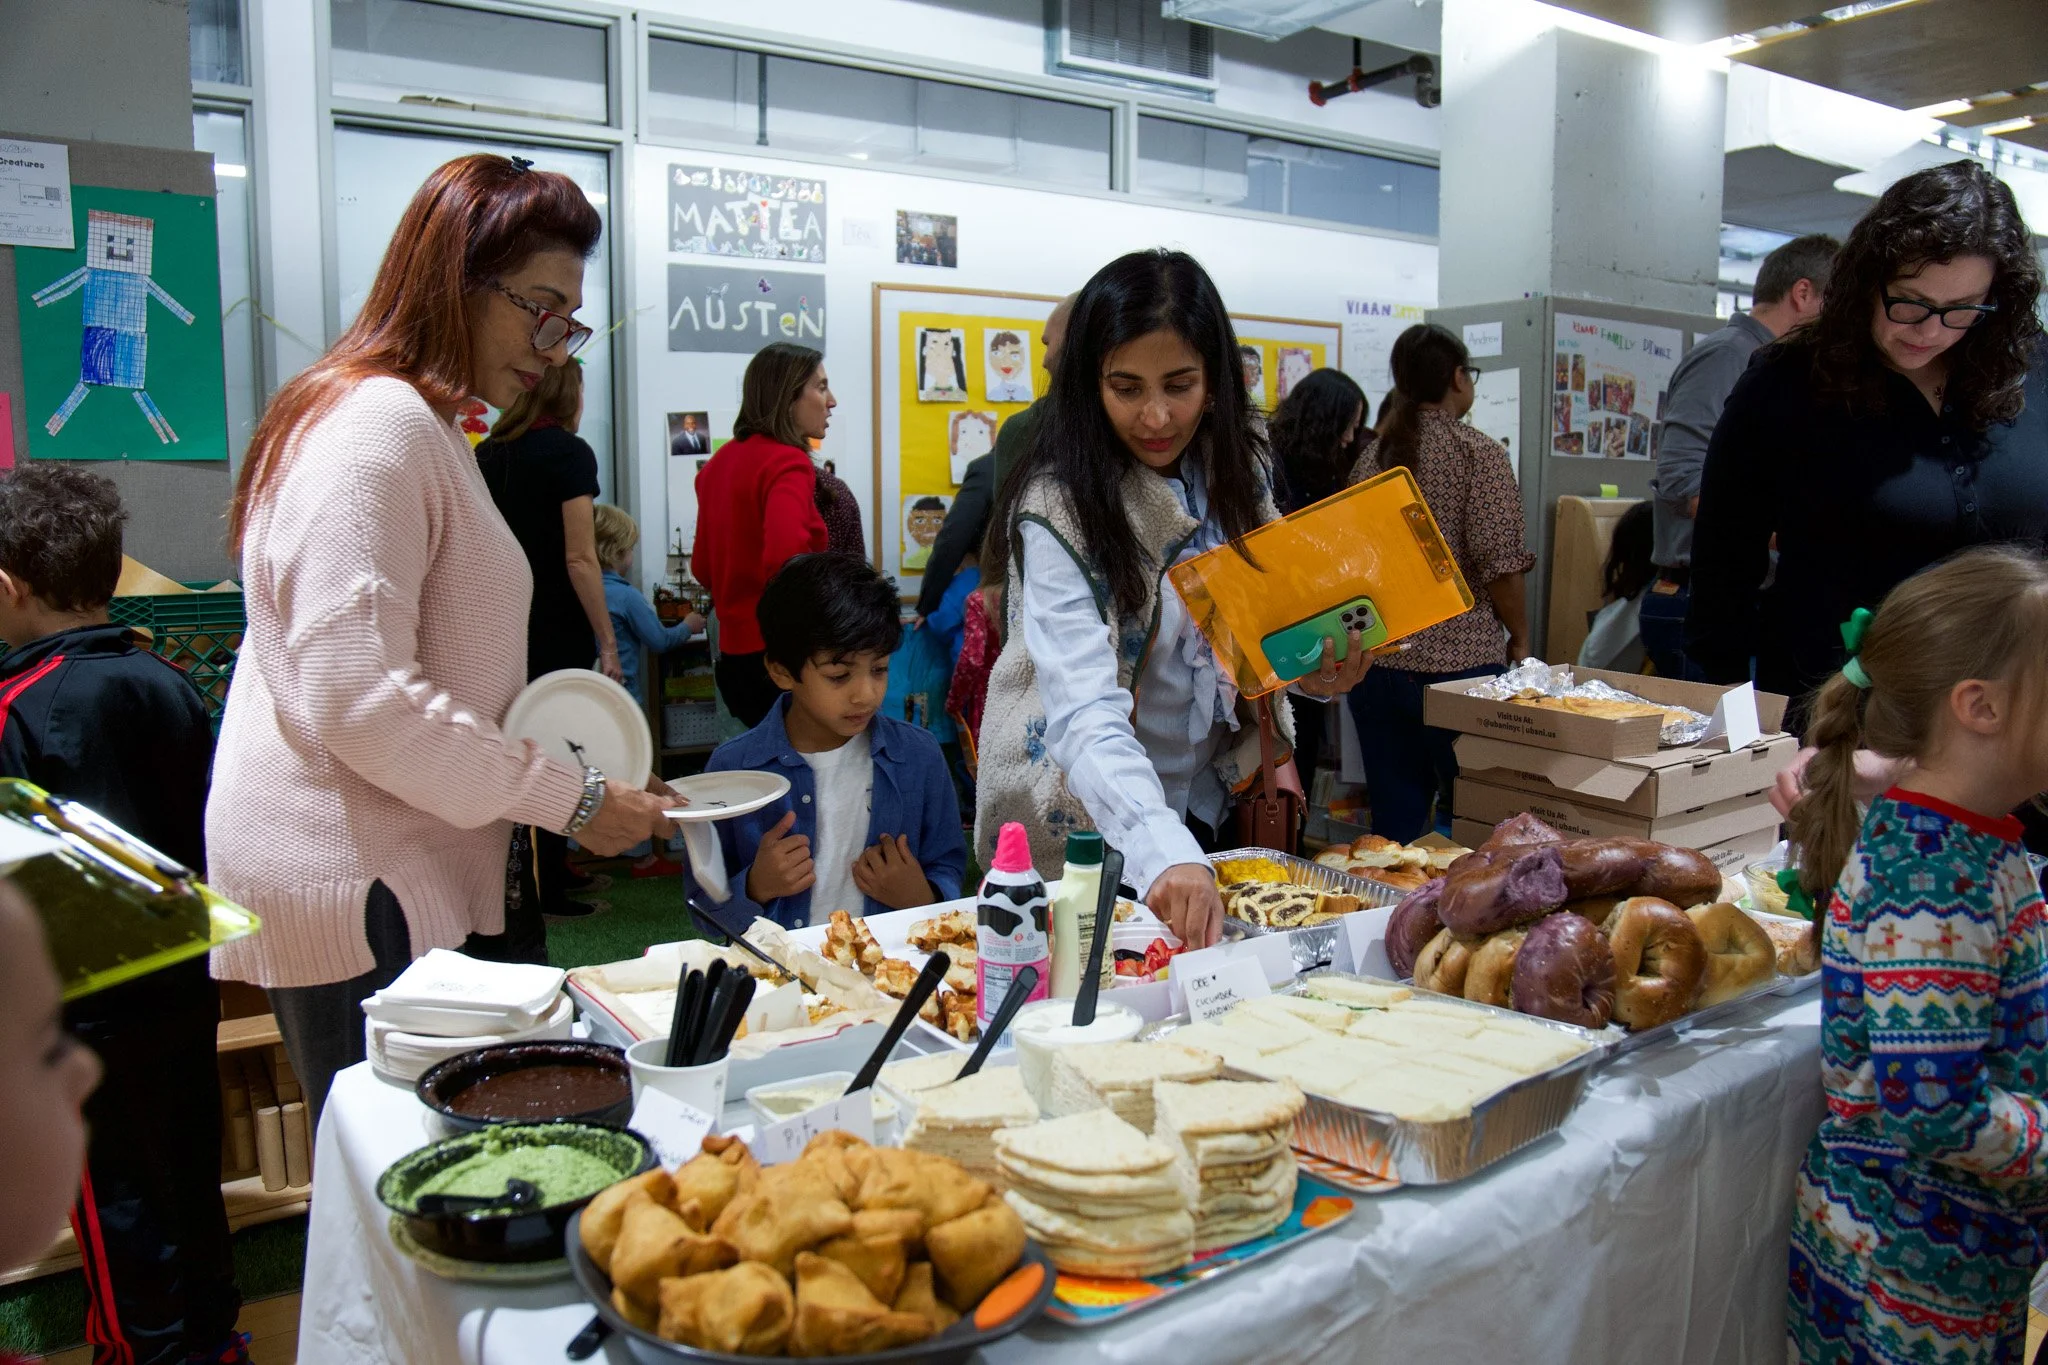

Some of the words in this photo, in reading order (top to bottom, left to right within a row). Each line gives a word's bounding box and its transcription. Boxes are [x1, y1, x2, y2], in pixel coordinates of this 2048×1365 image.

[674, 191, 823, 243] MATTEA
[1496, 711, 1512, 721] Visit
[1513, 714, 1522, 724] Us
[1522, 715, 1534, 725] At:
[1483, 718, 1521, 733] @ubaninyc
[1525, 726, 1556, 739] ubani.us
[1529, 805, 1545, 815] Visit
[1546, 808, 1556, 818] Us
[1556, 811, 1568, 821] At:
[1558, 822, 1591, 836] ubani.us
